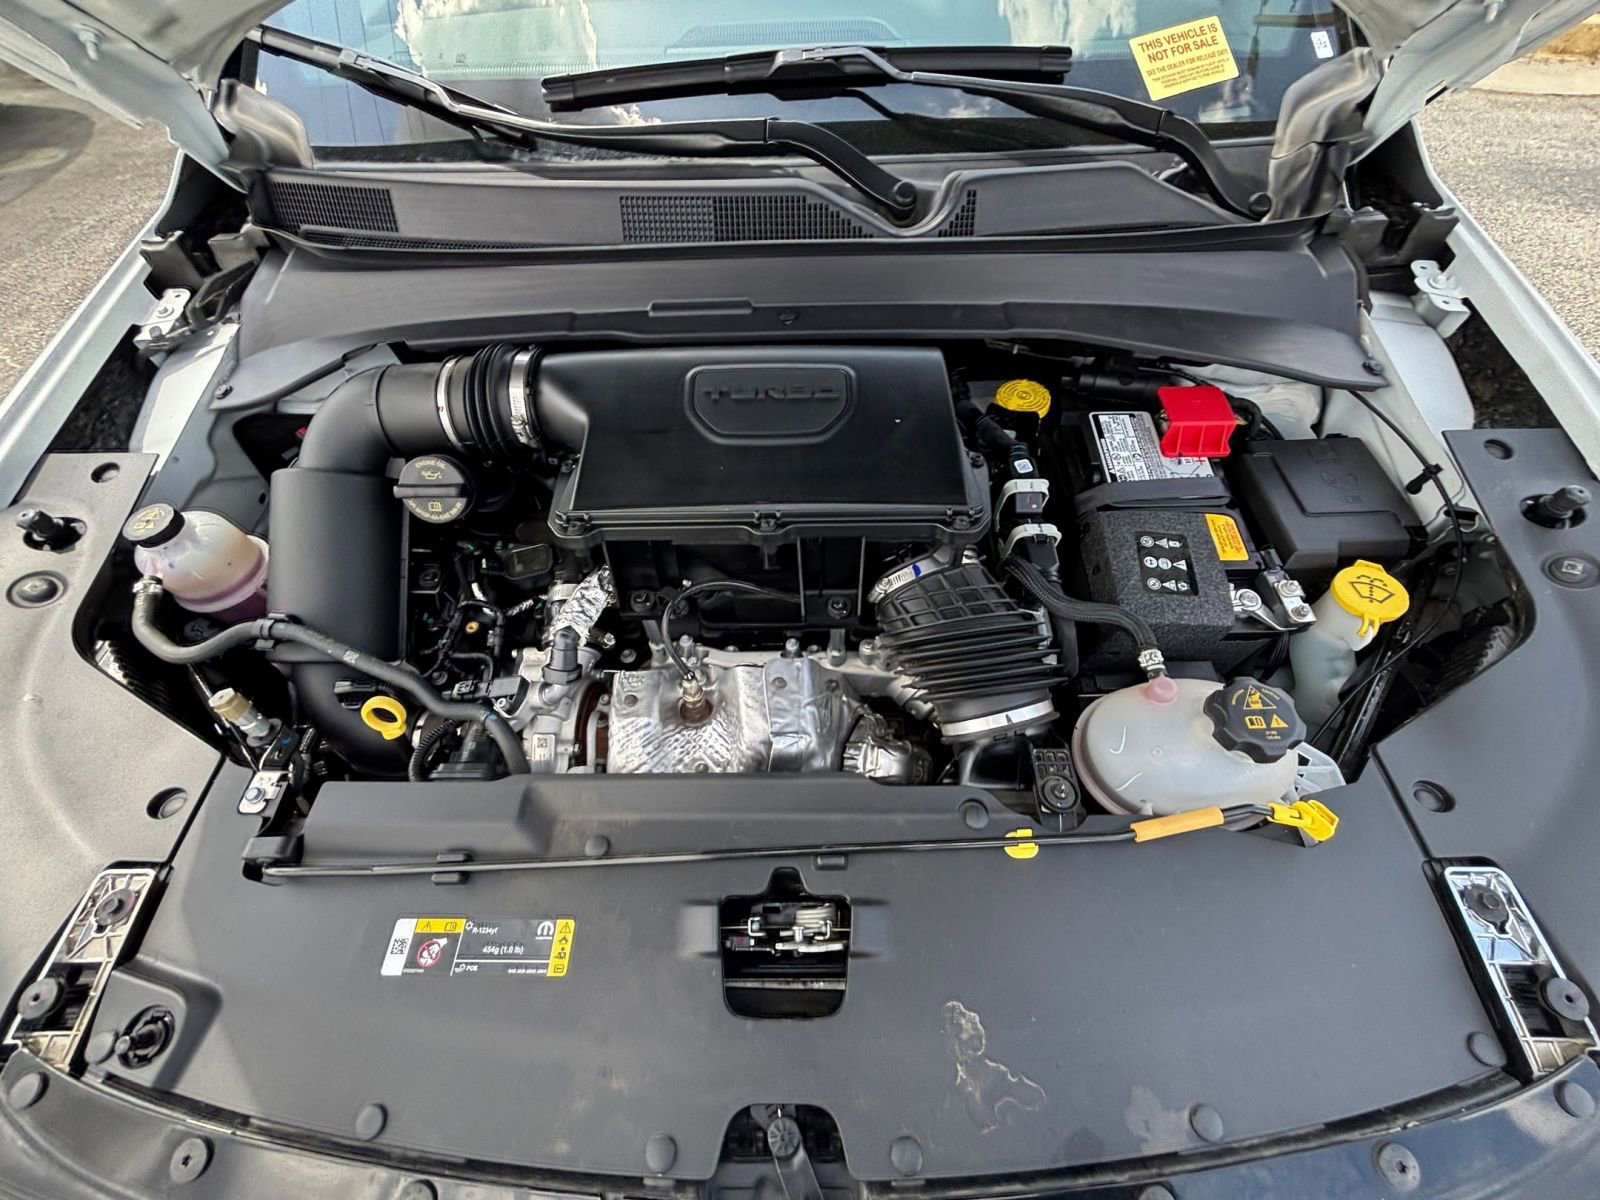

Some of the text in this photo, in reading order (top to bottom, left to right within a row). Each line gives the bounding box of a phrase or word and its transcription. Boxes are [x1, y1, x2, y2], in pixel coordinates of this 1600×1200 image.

[1138, 23, 1218, 52] THIS VEHICLE IS
[1147, 35, 1219, 63] NOT FOR SALE
[1156, 65, 1166, 74] THE
[1166, 59, 1185, 71] DEALER
[703, 386, 841, 402] TURBO
[482, 945, 499, 955] 454g
[500, 945, 513, 955] (1.0
